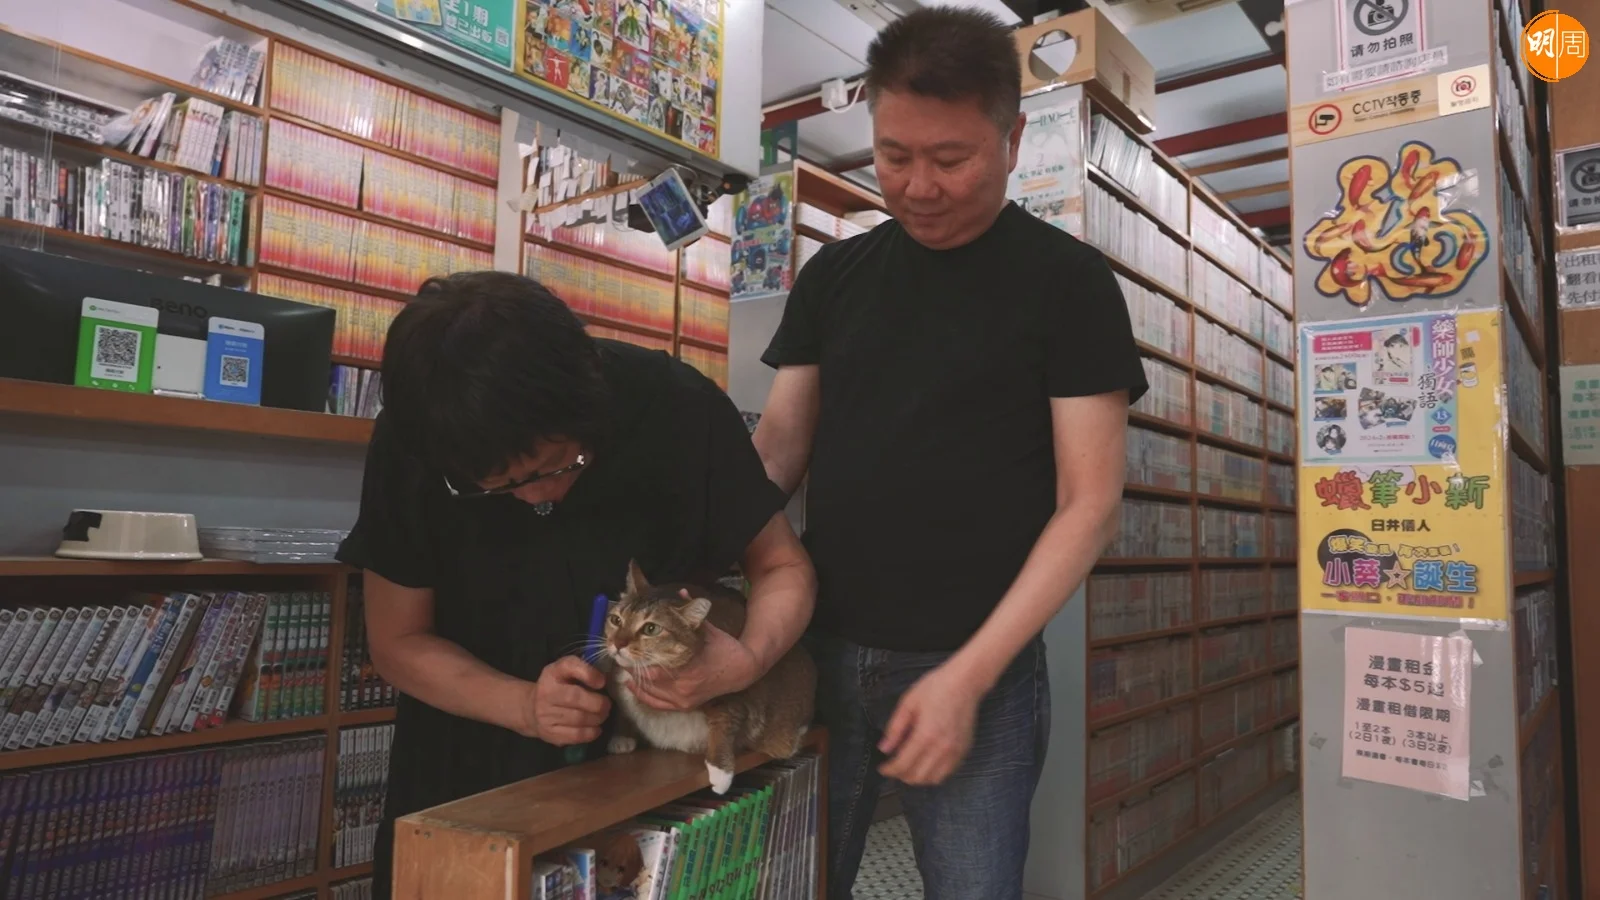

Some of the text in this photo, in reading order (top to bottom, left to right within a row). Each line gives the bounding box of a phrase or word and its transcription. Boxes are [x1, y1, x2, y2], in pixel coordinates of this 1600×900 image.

[1350, 32, 1414, 58] 请勿拍照
[1352, 89, 1422, 115] CCTV작동중
[1565, 253, 1600, 268] 出租
[1566, 271, 1600, 286] 翻看
[1567, 290, 1600, 304] 先付
[1315, 470, 1490, 510] 蠟筆小新
[1368, 654, 1435, 676] 漫畫租金
[1356, 697, 1451, 723] 漫畫租借限期
[1349, 730, 1397, 746] (2日1夜)
[1355, 721, 1449, 745] 1至2本 3本以上
